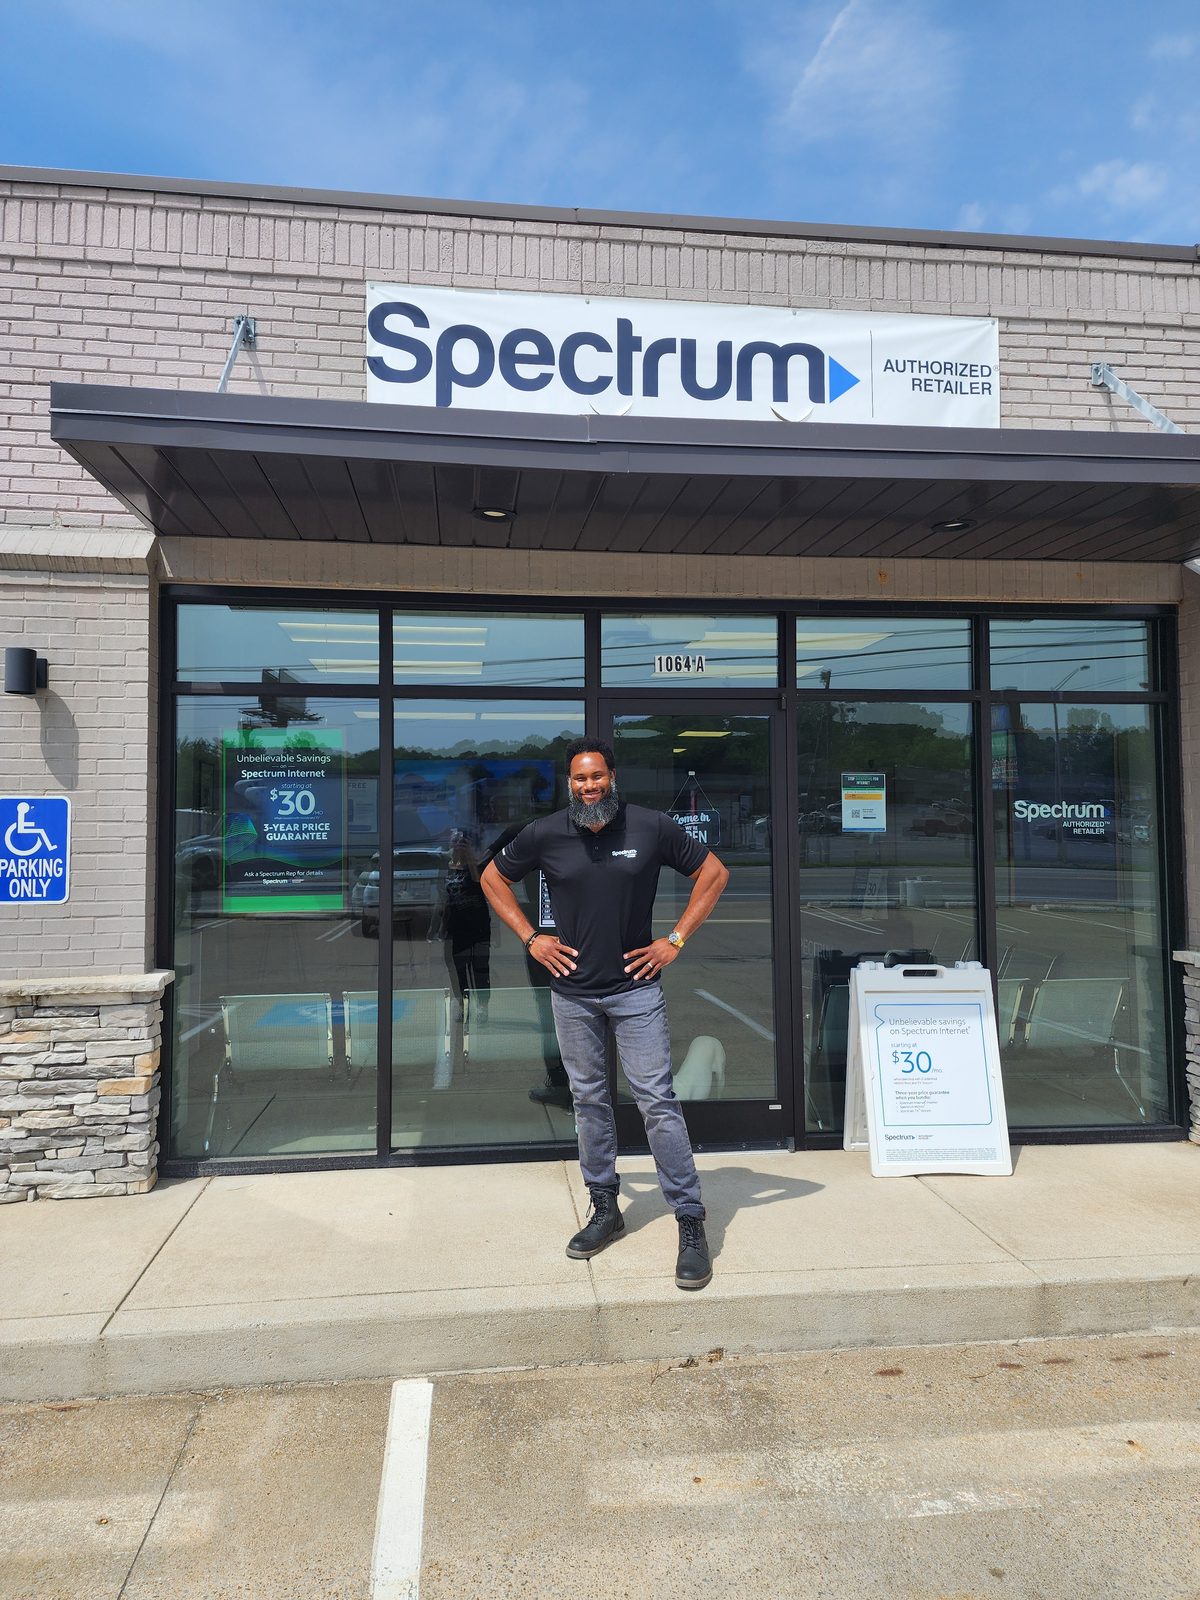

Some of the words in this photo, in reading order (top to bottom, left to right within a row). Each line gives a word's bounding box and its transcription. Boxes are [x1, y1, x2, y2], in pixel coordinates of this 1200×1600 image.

[367, 301, 826, 407] Spectrum
[911, 377, 992, 395] RETAILER
[657, 655, 692, 672] 1064
[696, 655, 705, 672] A
[236, 754, 295, 764] Unbelievable
[296, 754, 331, 765] Savings
[241, 769, 286, 780] Spectrum
[287, 769, 326, 778] Internet
[270, 788, 316, 816] $30
[673, 813, 700, 825] Come
[700, 812, 711, 822] in
[1014, 800, 1104, 822] Spectrum
[263, 823, 299, 832] 3-YEAR
[302, 822, 331, 831] PRICE
[266, 832, 328, 841] GUARANTEE
[0, 858, 63, 878] PARKING
[9, 878, 51, 898] ONLY
[889, 1018, 937, 1026] Unbelievable
[938, 1018, 966, 1027] savings
[901, 1028, 938, 1036] Spectrum
[892, 1050, 932, 1073] $30
